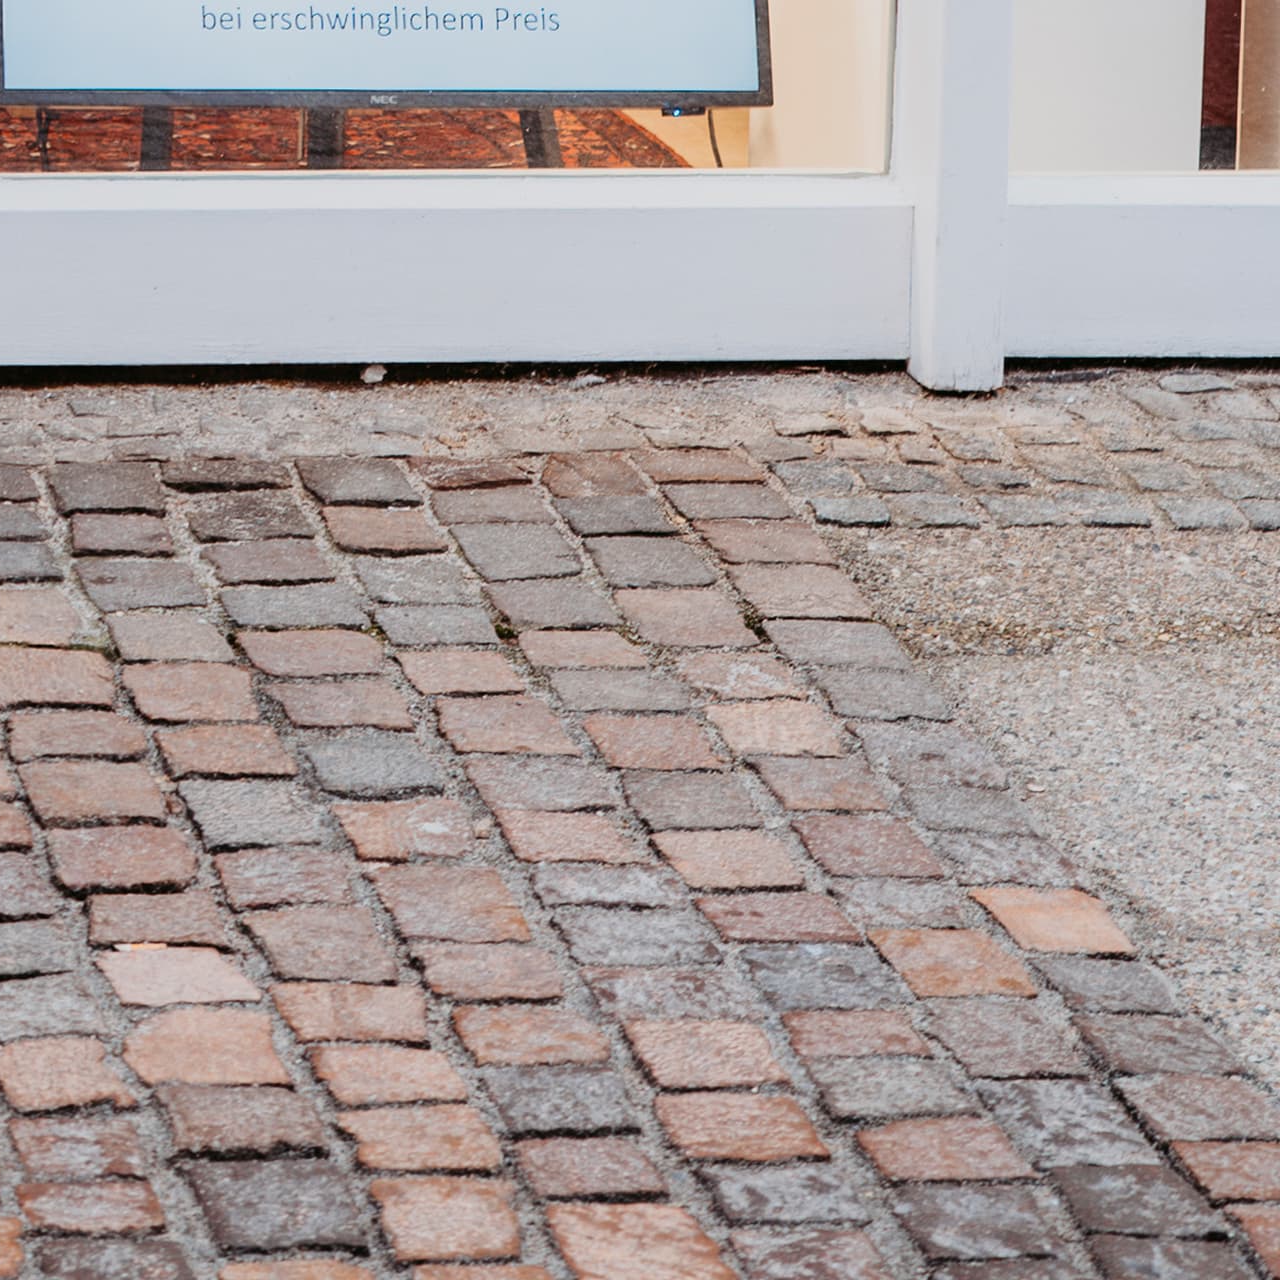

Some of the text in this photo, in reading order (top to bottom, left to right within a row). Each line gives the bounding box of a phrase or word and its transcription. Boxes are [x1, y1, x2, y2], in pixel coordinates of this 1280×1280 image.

[201, 6, 561, 37] bei erschwinglichem Preis
[370, 95, 398, 105] NEC
